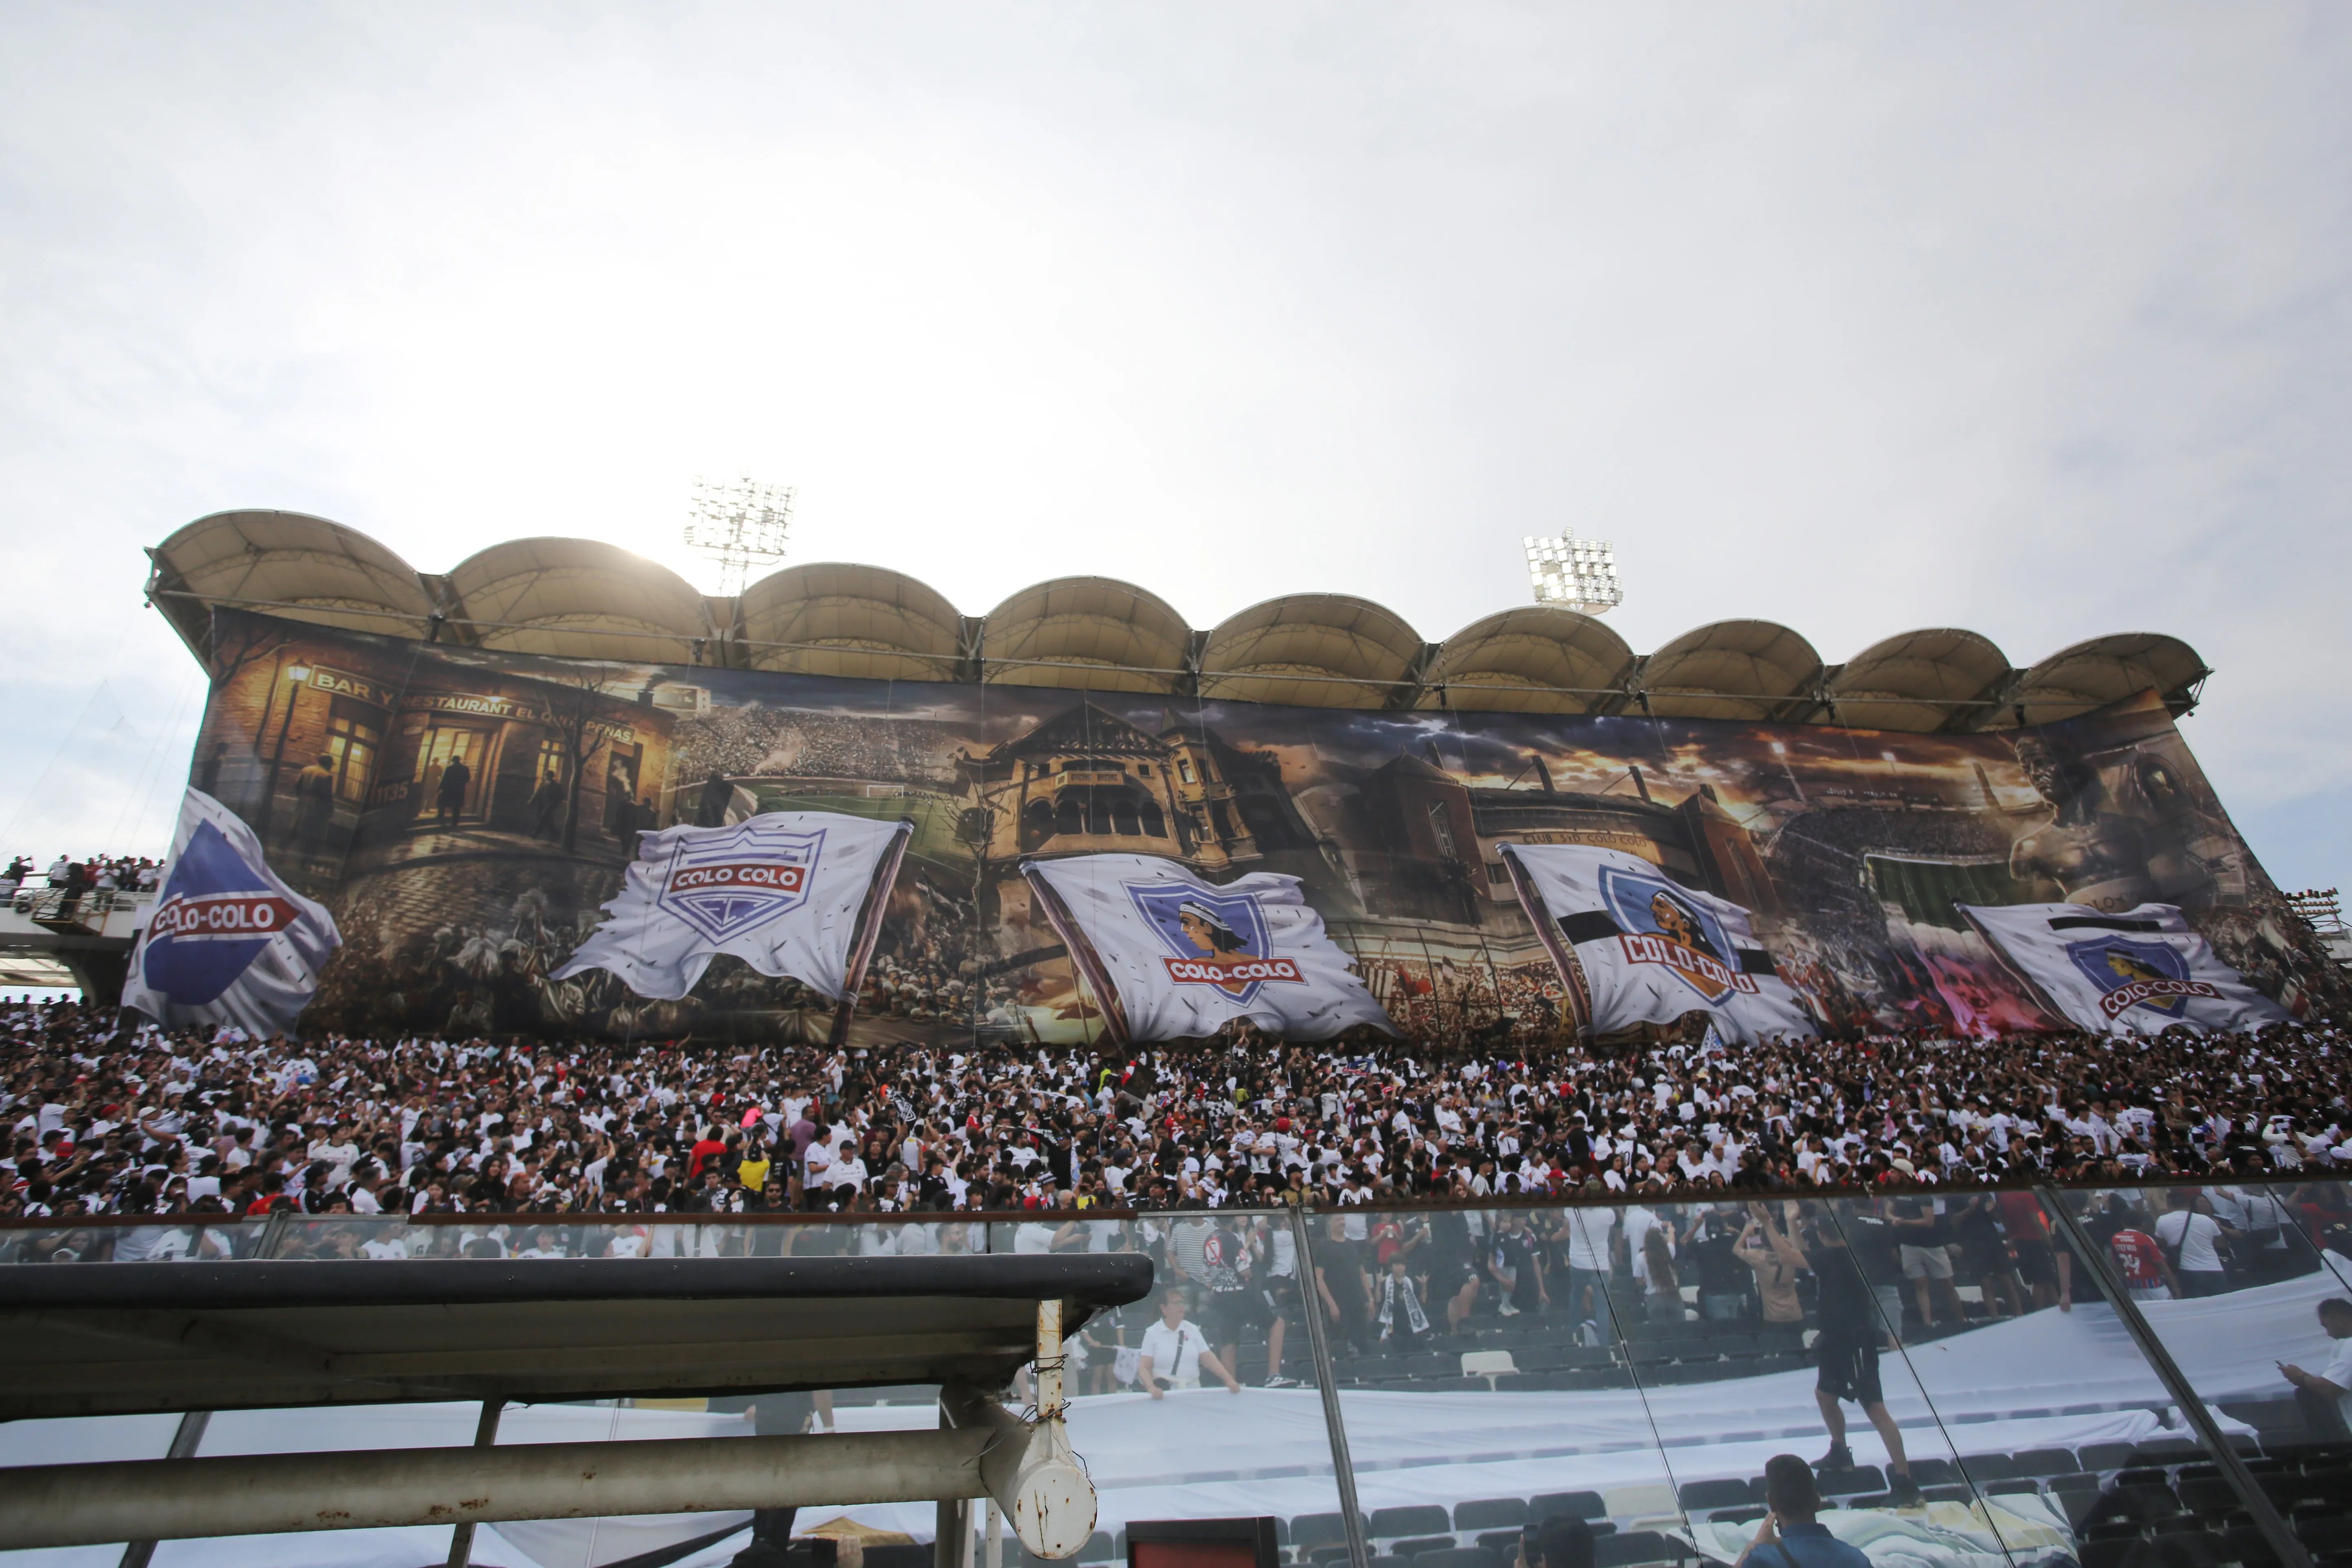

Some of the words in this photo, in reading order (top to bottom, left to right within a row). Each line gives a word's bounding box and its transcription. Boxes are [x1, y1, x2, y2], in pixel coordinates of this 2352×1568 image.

[317, 674, 370, 698] BAR
[379, 690, 393, 705] Y
[401, 696, 512, 714] RESTAURANT
[516, 707, 536, 719] EL
[1523, 834, 1552, 844] CLUB
[1587, 834, 1617, 844] COLO
[1620, 837, 1647, 847] COLO
[676, 868, 733, 886] COLO
[738, 867, 797, 886] COLO
[155, 904, 274, 931] COLO-COLO
[1170, 962, 1295, 981] COLO-COLO
[1624, 935, 1756, 992] COLO-COLO
[2105, 981, 2215, 1013] COLO-COLO
